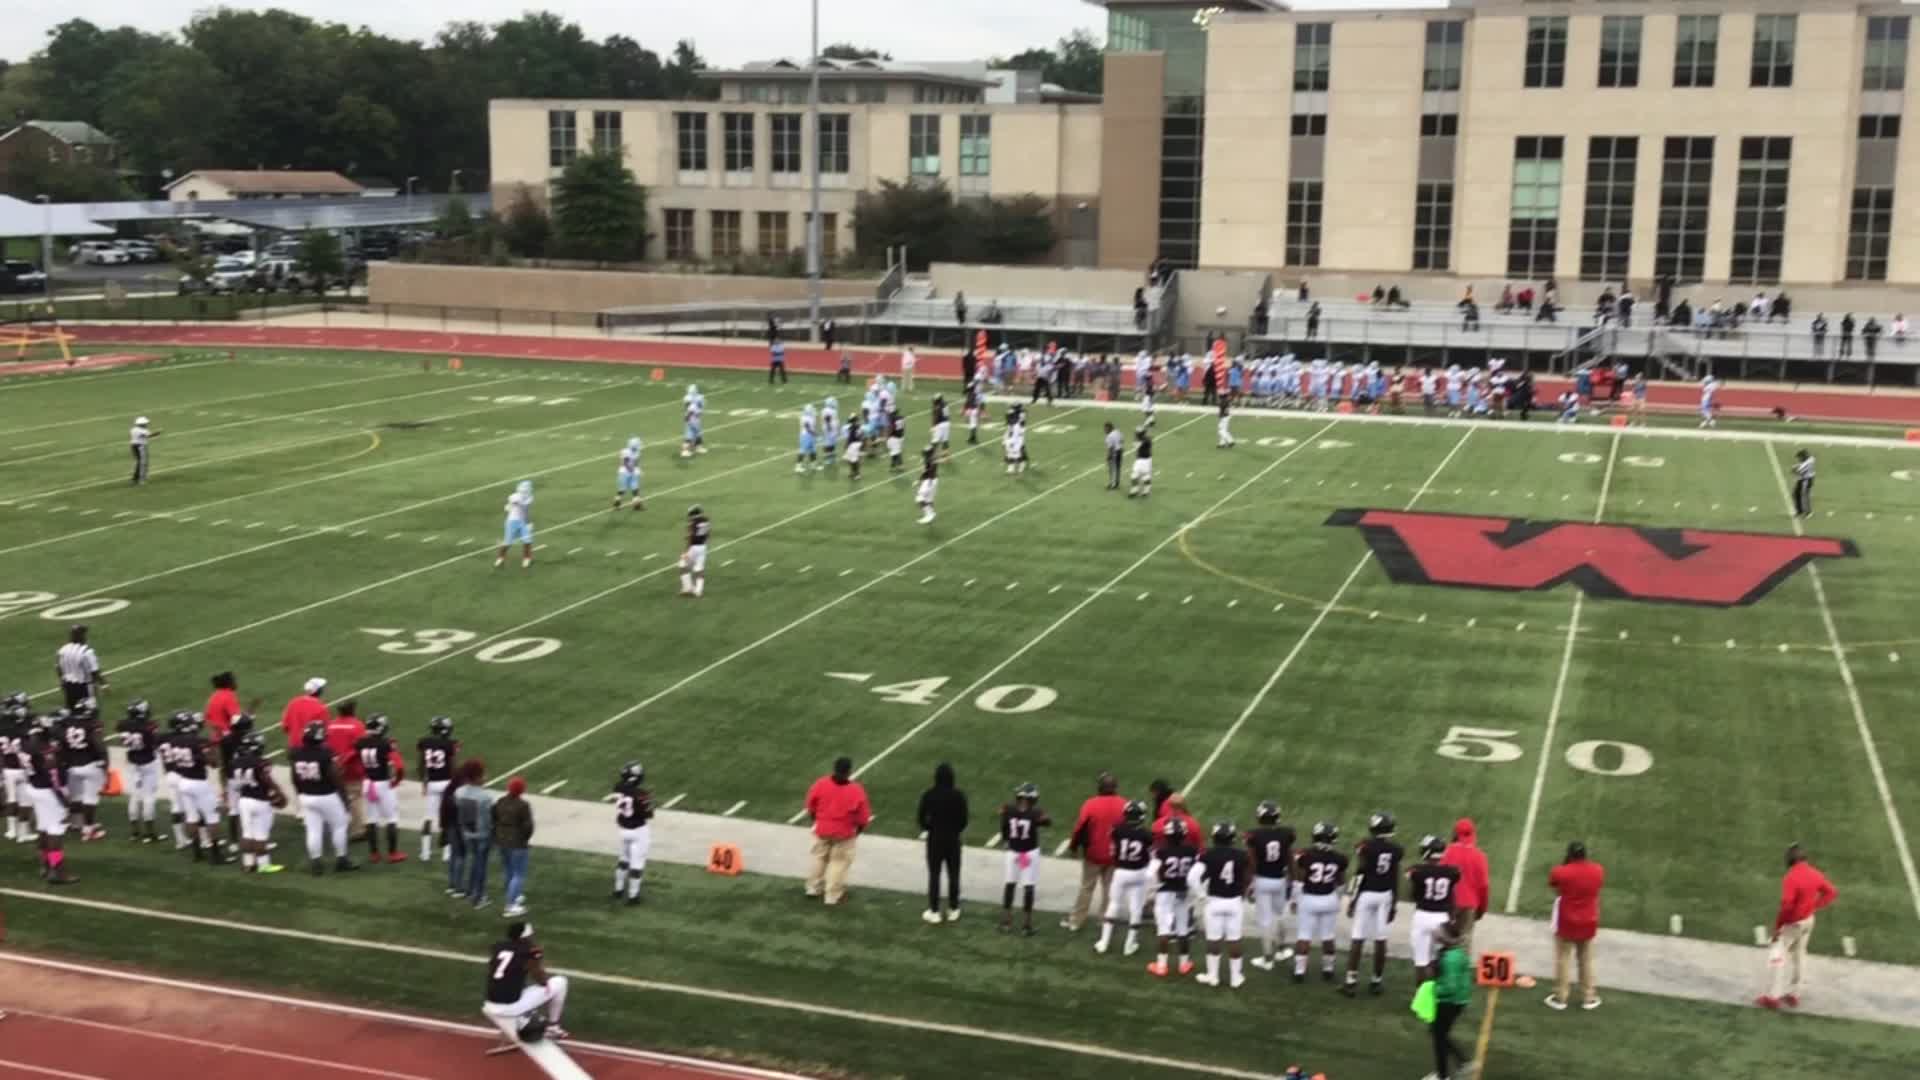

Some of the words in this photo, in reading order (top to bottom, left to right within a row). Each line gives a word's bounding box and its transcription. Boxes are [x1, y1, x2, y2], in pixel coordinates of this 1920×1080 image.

[1009, 818, 1031, 839] 17
[711, 850, 733, 870] 40
[1119, 839, 1143, 861] 12
[1220, 860, 1235, 885] 4
[1309, 863, 1338, 883] 32
[1424, 877, 1450, 900] 19
[494, 950, 514, 979] 7
[1482, 956, 1506, 981] 50
